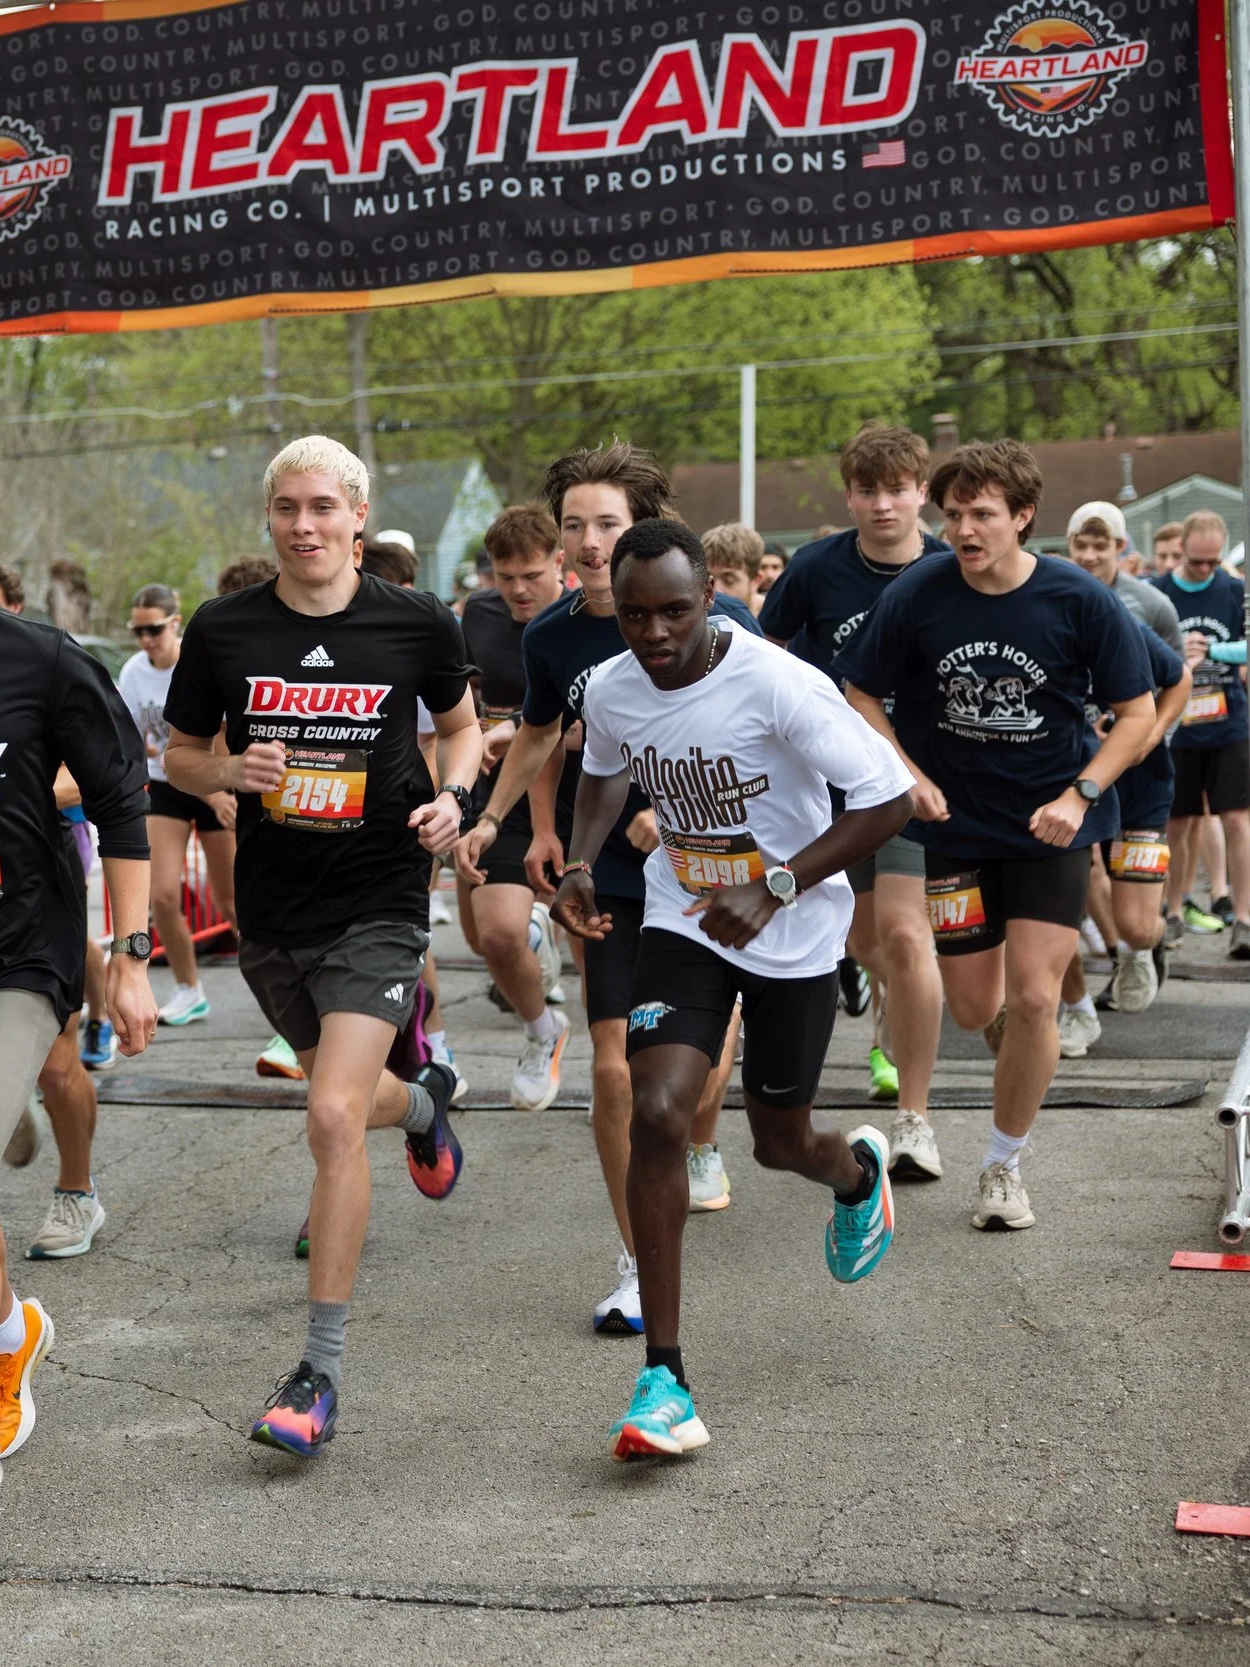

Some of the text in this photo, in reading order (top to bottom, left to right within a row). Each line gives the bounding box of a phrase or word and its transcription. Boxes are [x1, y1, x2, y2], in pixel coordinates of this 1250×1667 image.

[227, 21, 406, 56] MULTISPORT
[86, 65, 258, 103] MULTISPORT
[516, 12, 707, 53] MULTISPORT
[957, 43, 1146, 80] HEARTLAND
[100, 20, 924, 203] HEARTLAND
[105, 208, 229, 240] RACING
[247, 199, 302, 223] CO.
[353, 176, 565, 217] MULTISPORT
[585, 149, 847, 195] PRODUCTIONS
[96, 243, 268, 278] MULTISPORT
[525, 201, 717, 237] MULTISPORT
[316, 251, 498, 288] MULTISPORT
[770, 208, 972, 247] MULTISPORT
[300, 658, 334, 667] adidas
[1001, 644, 1048, 686] HOUSE
[248, 679, 388, 718] DRURY
[249, 723, 382, 741] CROSS COUNTRY
[280, 775, 349, 813] 2154
[717, 779, 766, 802] RUN CLUB
[687, 855, 750, 887] 2098
[930, 895, 969, 927] 2147
[629, 1008, 664, 1032] MT
